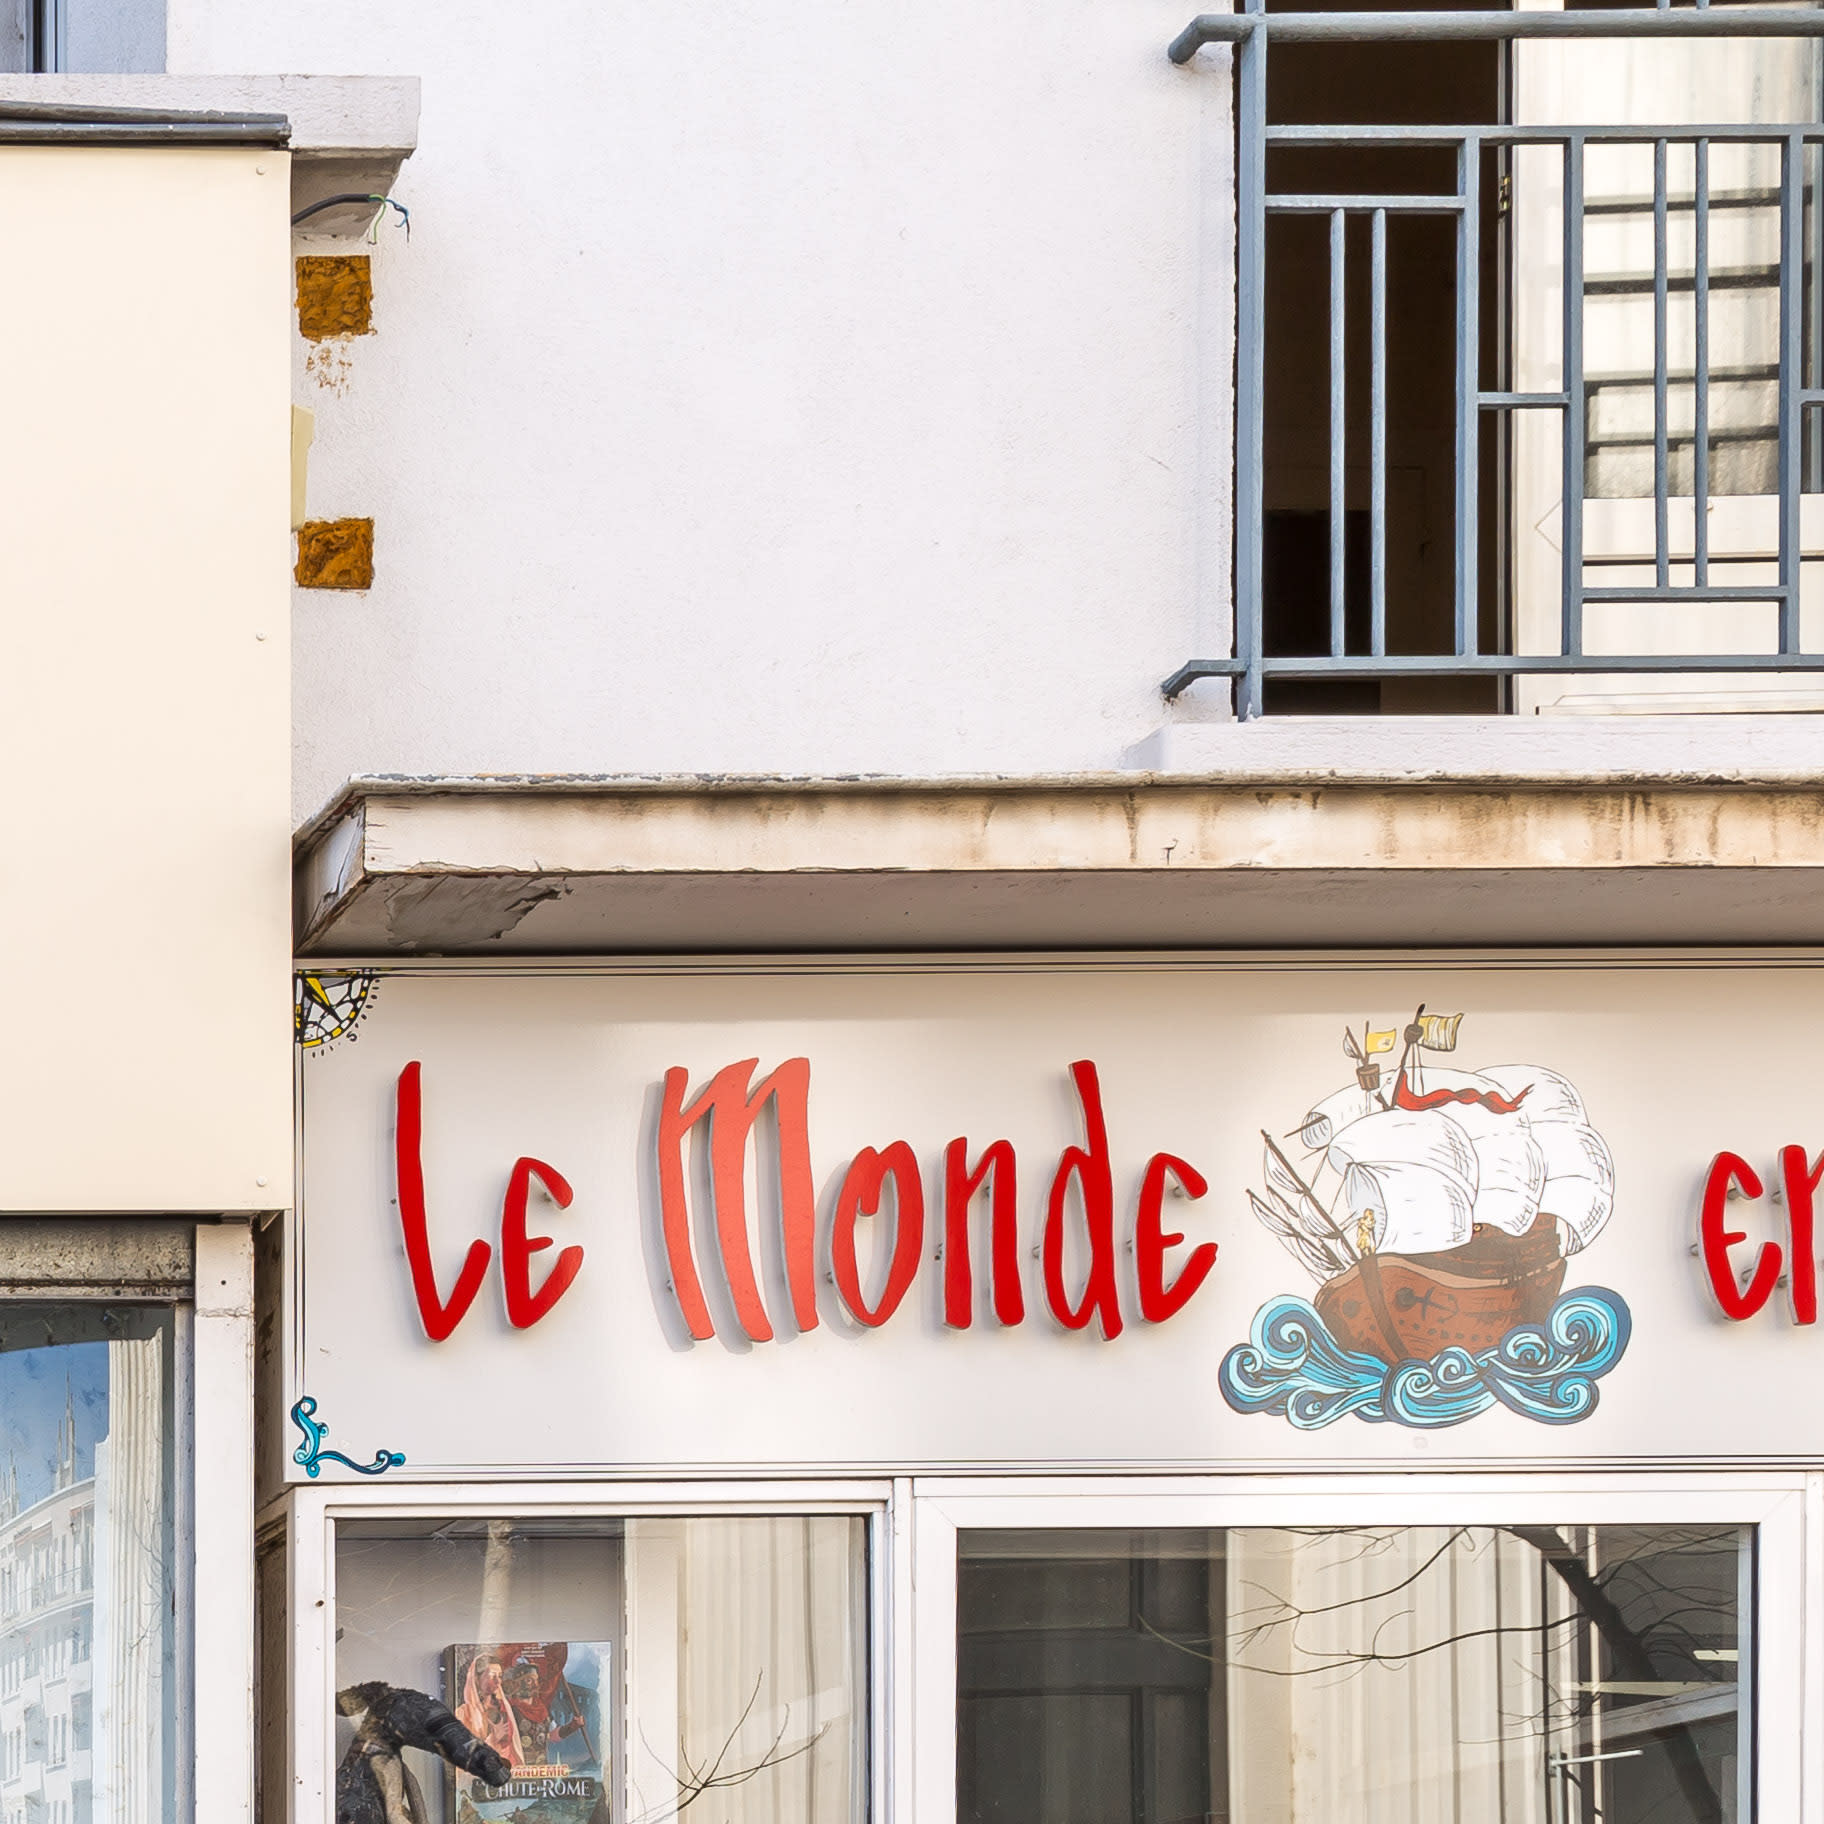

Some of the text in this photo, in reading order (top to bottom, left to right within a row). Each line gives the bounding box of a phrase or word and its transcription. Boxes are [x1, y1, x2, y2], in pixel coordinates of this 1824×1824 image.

[396, 1060, 585, 1343] Le
[660, 1056, 1221, 1345] Monde
[511, 1764, 570, 1778] ANDEMIC
